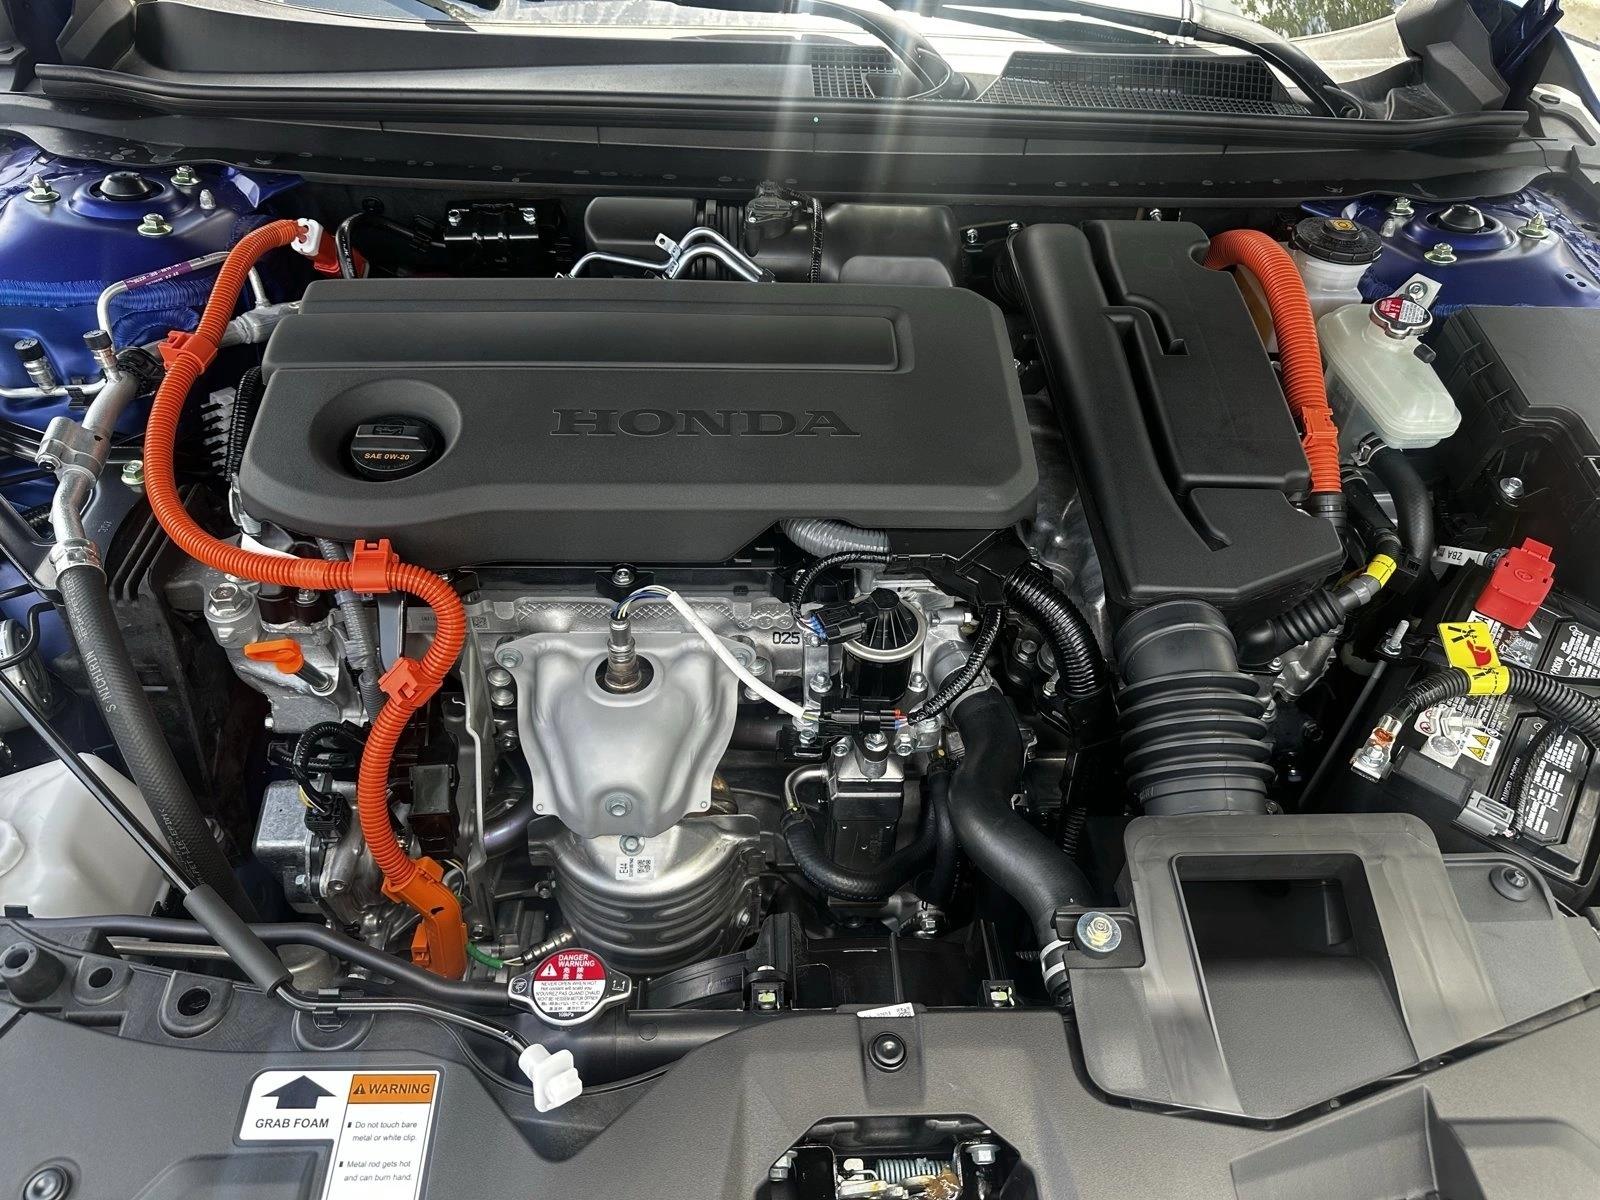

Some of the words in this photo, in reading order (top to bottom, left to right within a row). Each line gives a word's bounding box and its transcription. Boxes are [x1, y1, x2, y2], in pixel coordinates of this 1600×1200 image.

[550, 408, 861, 437] HONDA
[364, 452, 382, 460] SAE
[384, 453, 410, 461] 0W-20
[772, 631, 801, 645] 025
[558, 960, 595, 968] WARNUNG
[369, 1083, 430, 1095] WARNING
[255, 1118, 290, 1129] GRAB
[293, 1118, 330, 1129] FOAM
[355, 1121, 366, 1129] Do
[380, 1121, 400, 1129] touch
[401, 1121, 418, 1129] bare
[352, 1134, 373, 1142] metal
[383, 1134, 402, 1142] white
[403, 1134, 417, 1143] clip.
[347, 1160, 368, 1169] Metal
[368, 1160, 380, 1168] rod
[382, 1161, 398, 1170] gets
[399, 1160, 411, 1168] hot
[344, 1174, 358, 1182] and
[360, 1174, 373, 1182] can
[375, 1174, 391, 1182] burn
[393, 1173, 413, 1182] hand.
